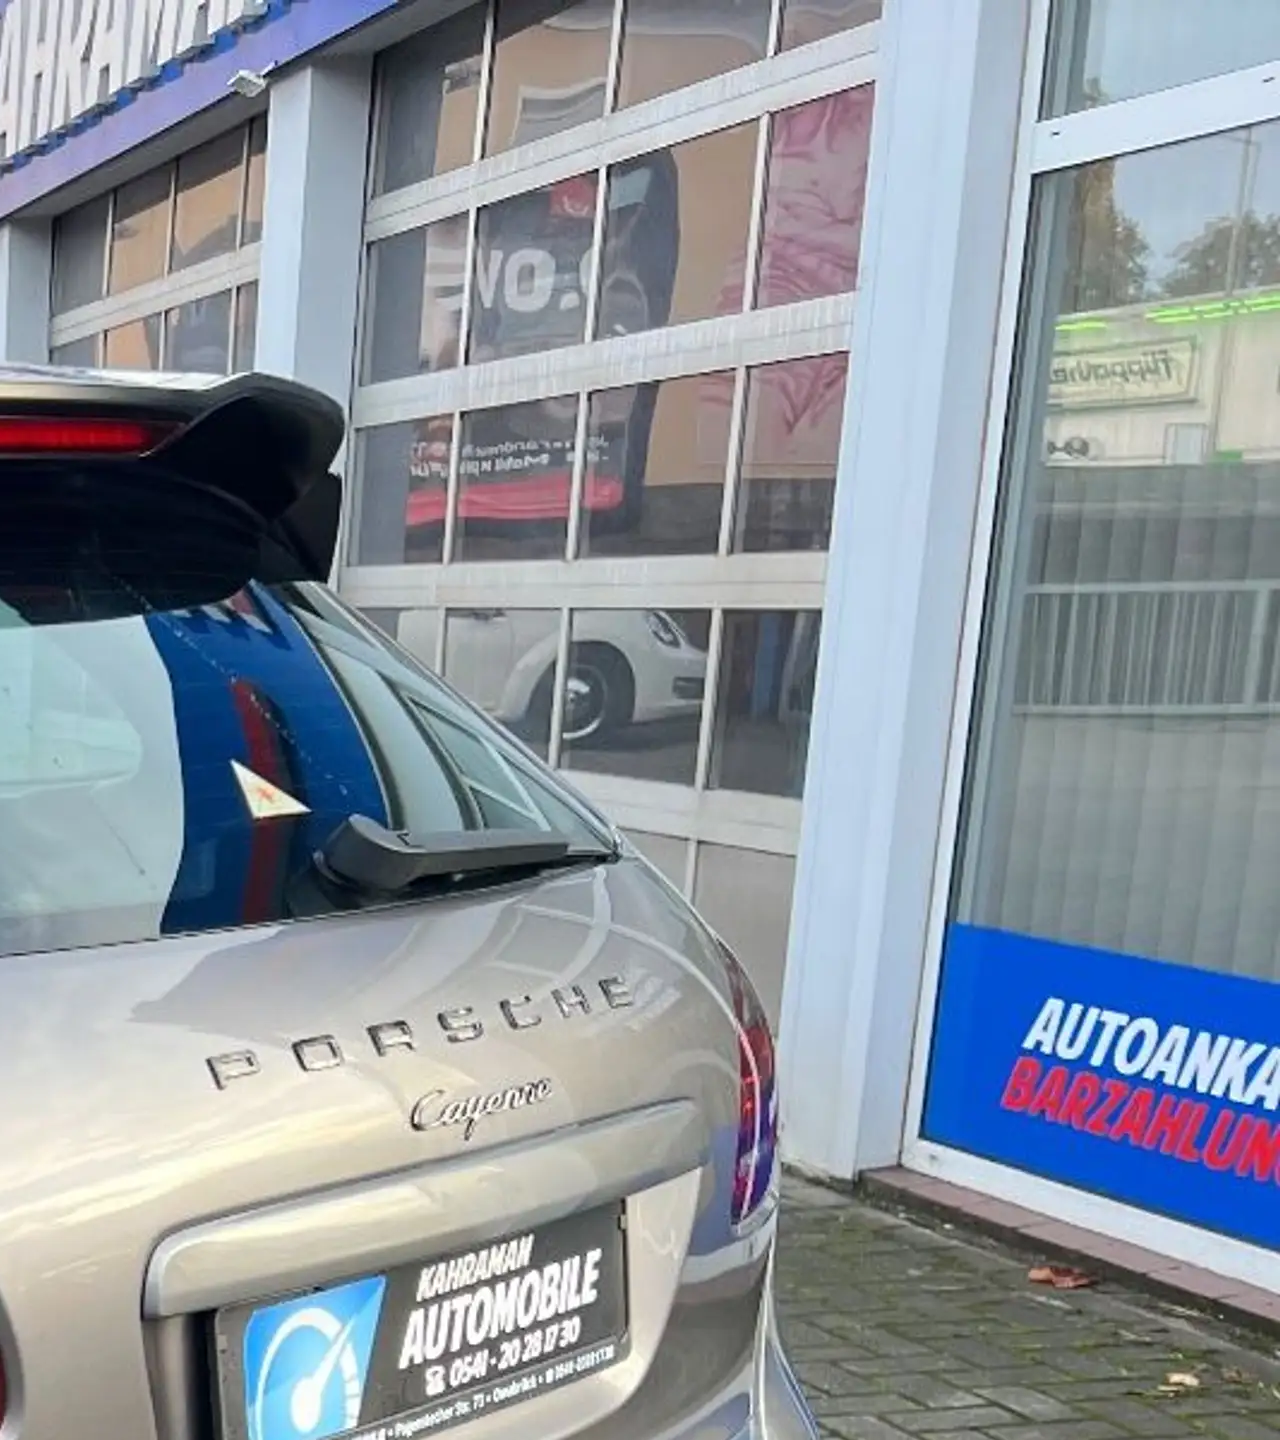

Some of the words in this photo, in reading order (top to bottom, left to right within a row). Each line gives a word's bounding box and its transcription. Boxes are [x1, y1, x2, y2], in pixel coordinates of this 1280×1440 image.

[205, 975, 637, 1091] PORSCHE
[409, 1077, 553, 1141] Cayenne
[1000, 1055, 1280, 1187] BARZAHLUN
[398, 1248, 602, 1370] AUTOMOBILE
[416, 1233, 536, 1302] KAHRAMAN
[449, 1349, 489, 1387] 0541
[497, 1338, 521, 1370] 20
[521, 1329, 543, 1362] 28
[543, 1322, 559, 1353] 17
[558, 1315, 582, 1348] 30
